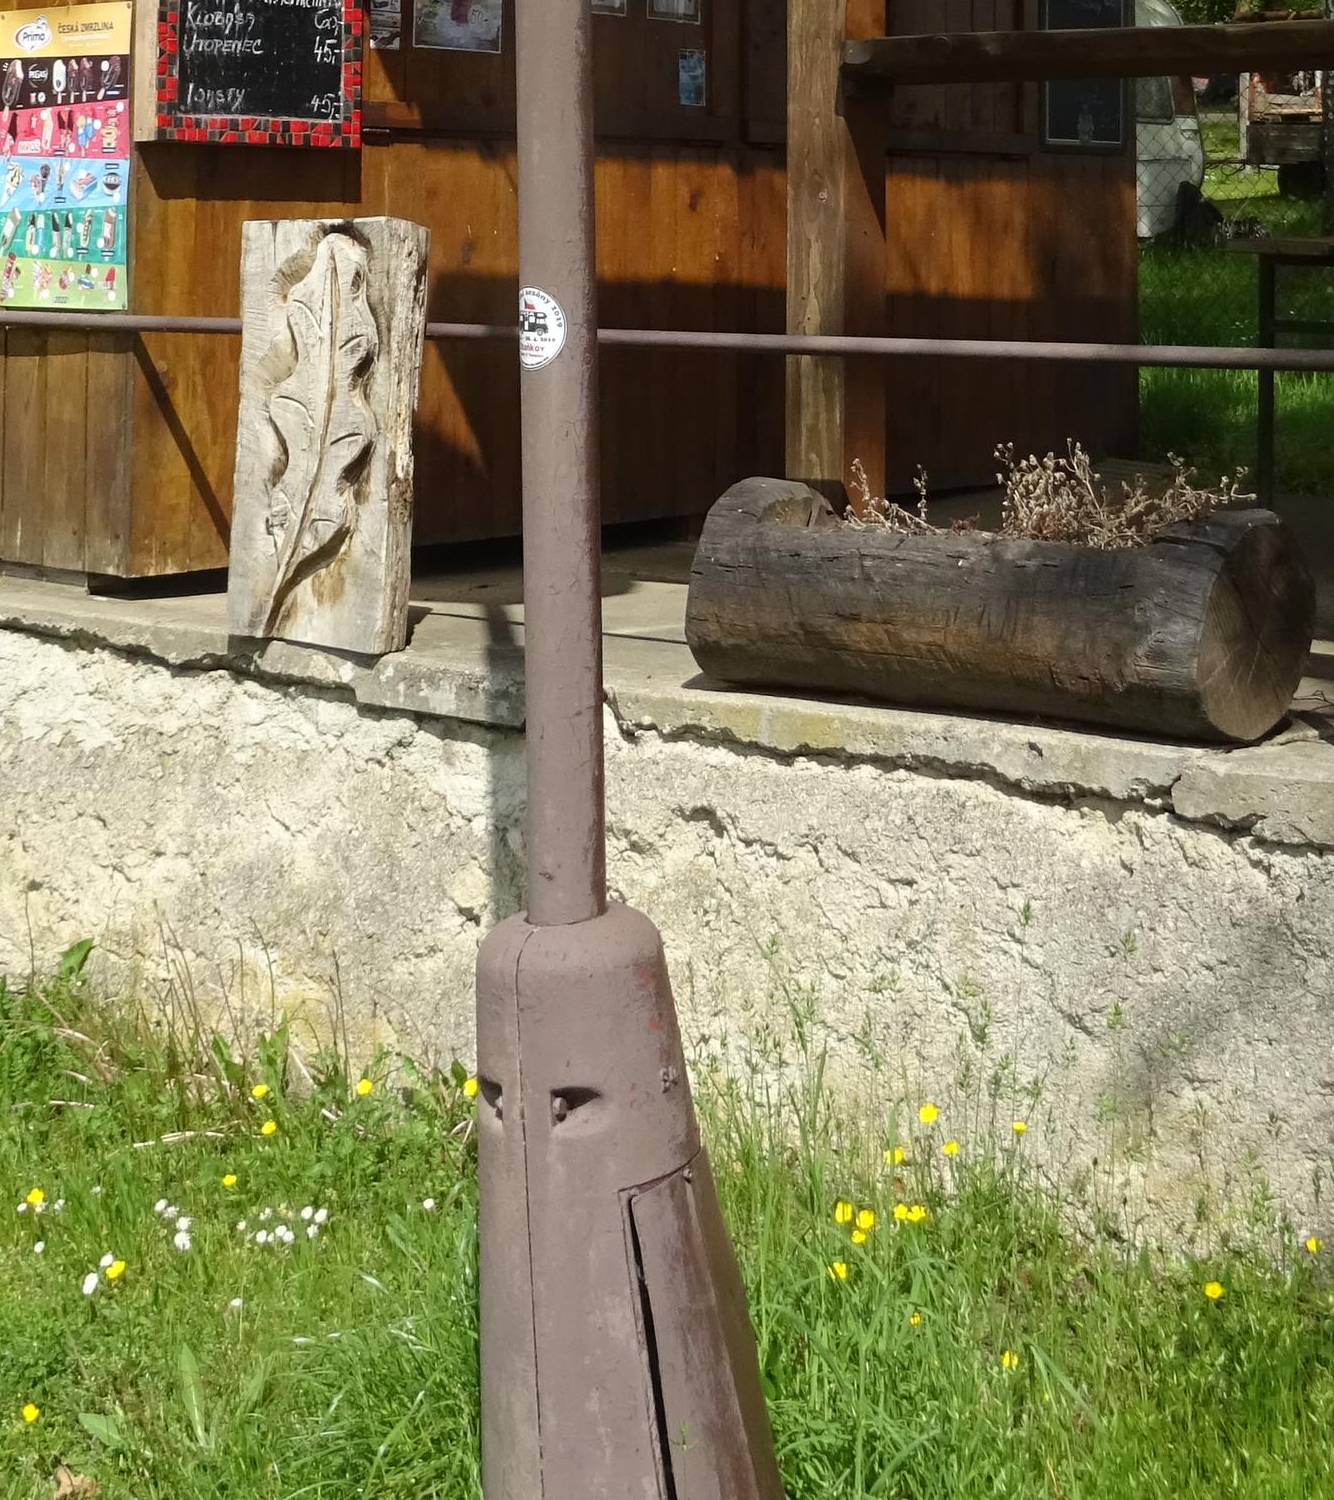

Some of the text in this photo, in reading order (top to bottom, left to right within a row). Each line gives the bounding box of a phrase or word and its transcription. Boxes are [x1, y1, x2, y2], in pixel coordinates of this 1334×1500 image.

[22, 31, 46, 42] Prima
[80, 21, 114, 33] ZMRZLINA
[551, 305, 563, 328] 2019
